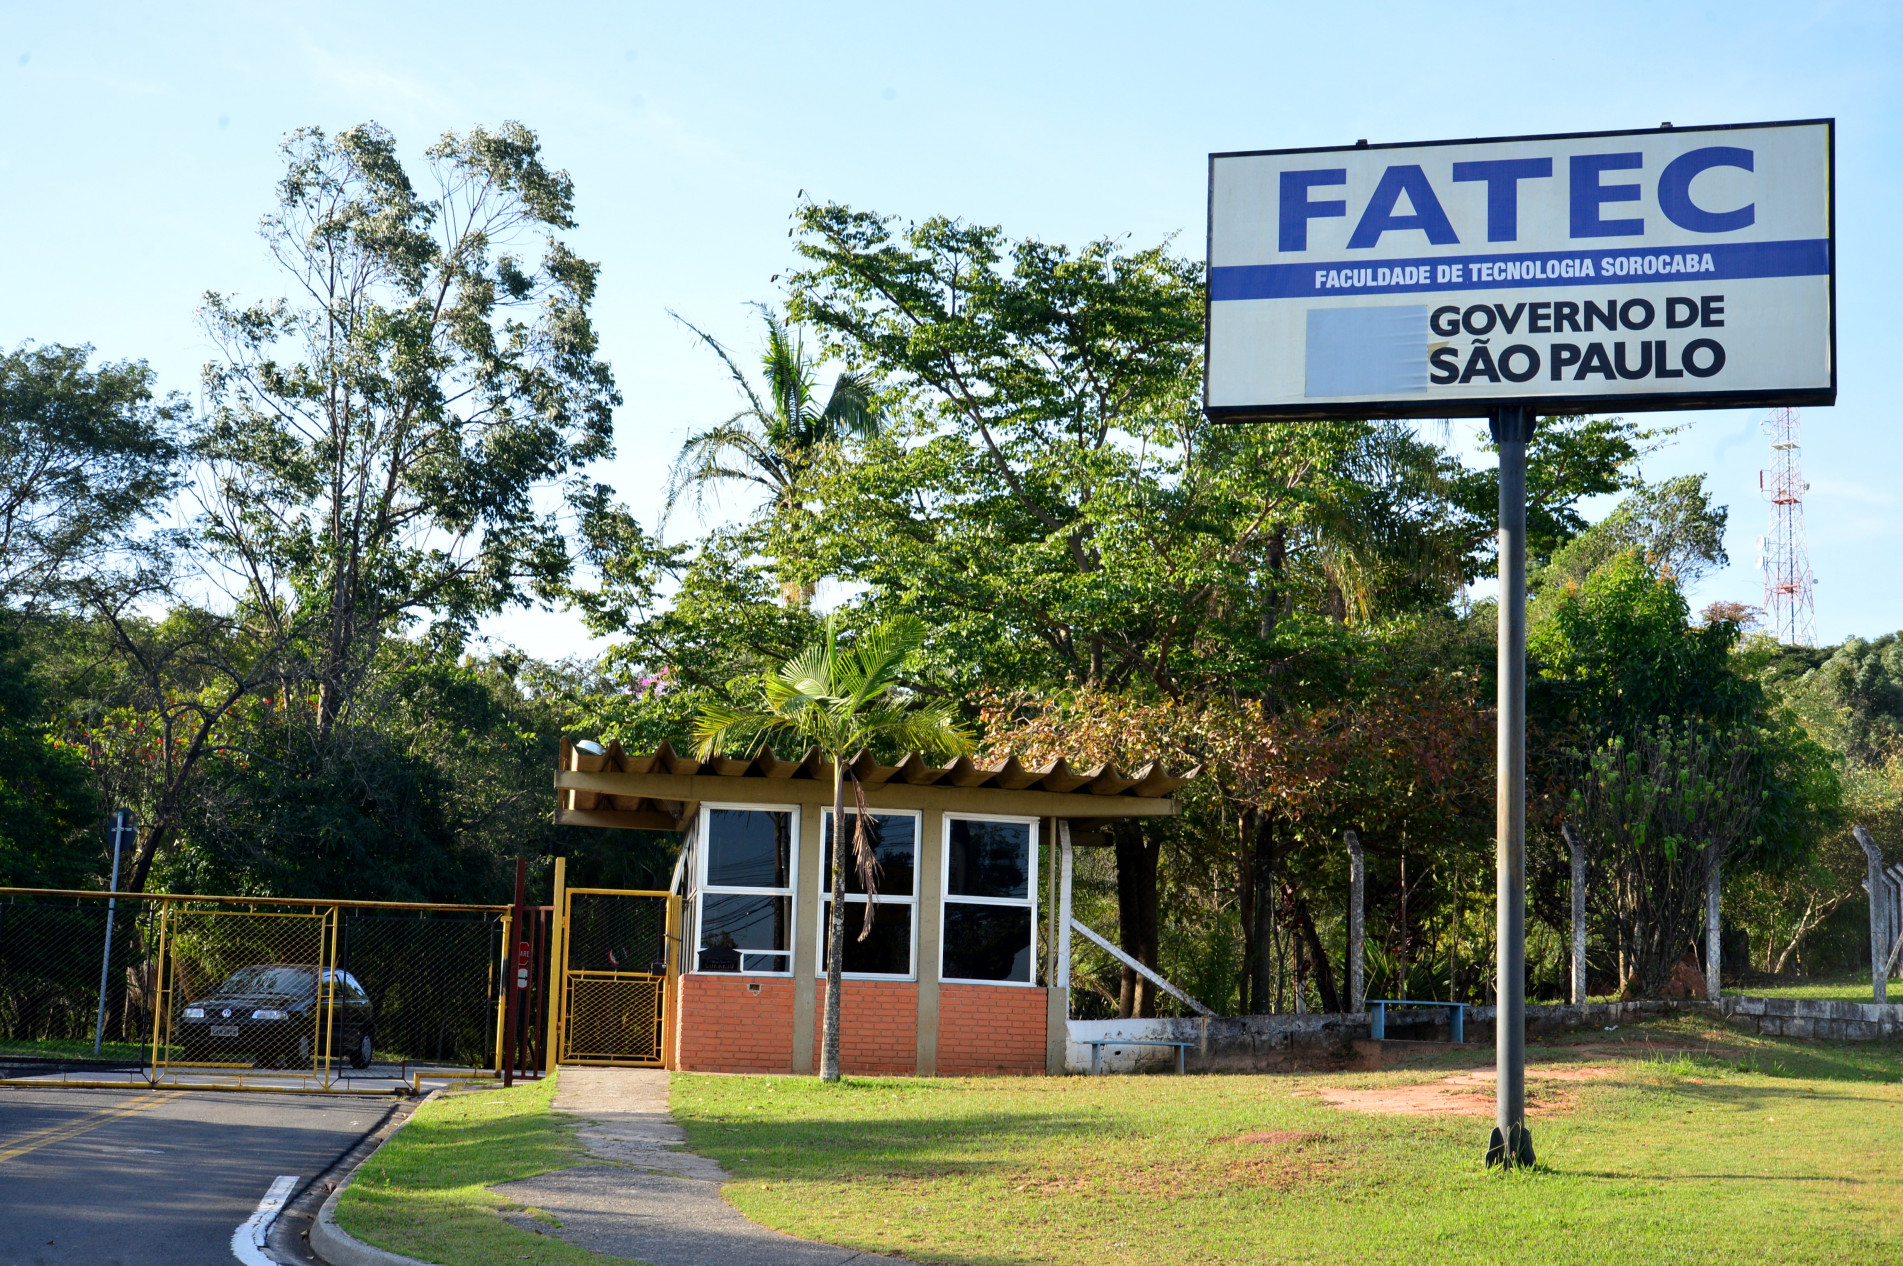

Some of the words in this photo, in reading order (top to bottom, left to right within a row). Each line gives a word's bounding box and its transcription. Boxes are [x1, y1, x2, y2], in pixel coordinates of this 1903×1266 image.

[1278, 146, 1755, 253] FATEC
[1315, 266, 1430, 289] FACULDADE
[1437, 264, 1463, 284] DE
[1469, 258, 1595, 282] TECNOLOGIA
[1601, 253, 1715, 276] SOROCABA
[1430, 298, 1655, 337] GOVERNO
[1666, 295, 1725, 329] DE
[1430, 338, 1541, 385] SÃO
[1550, 338, 1726, 381] PAULO
